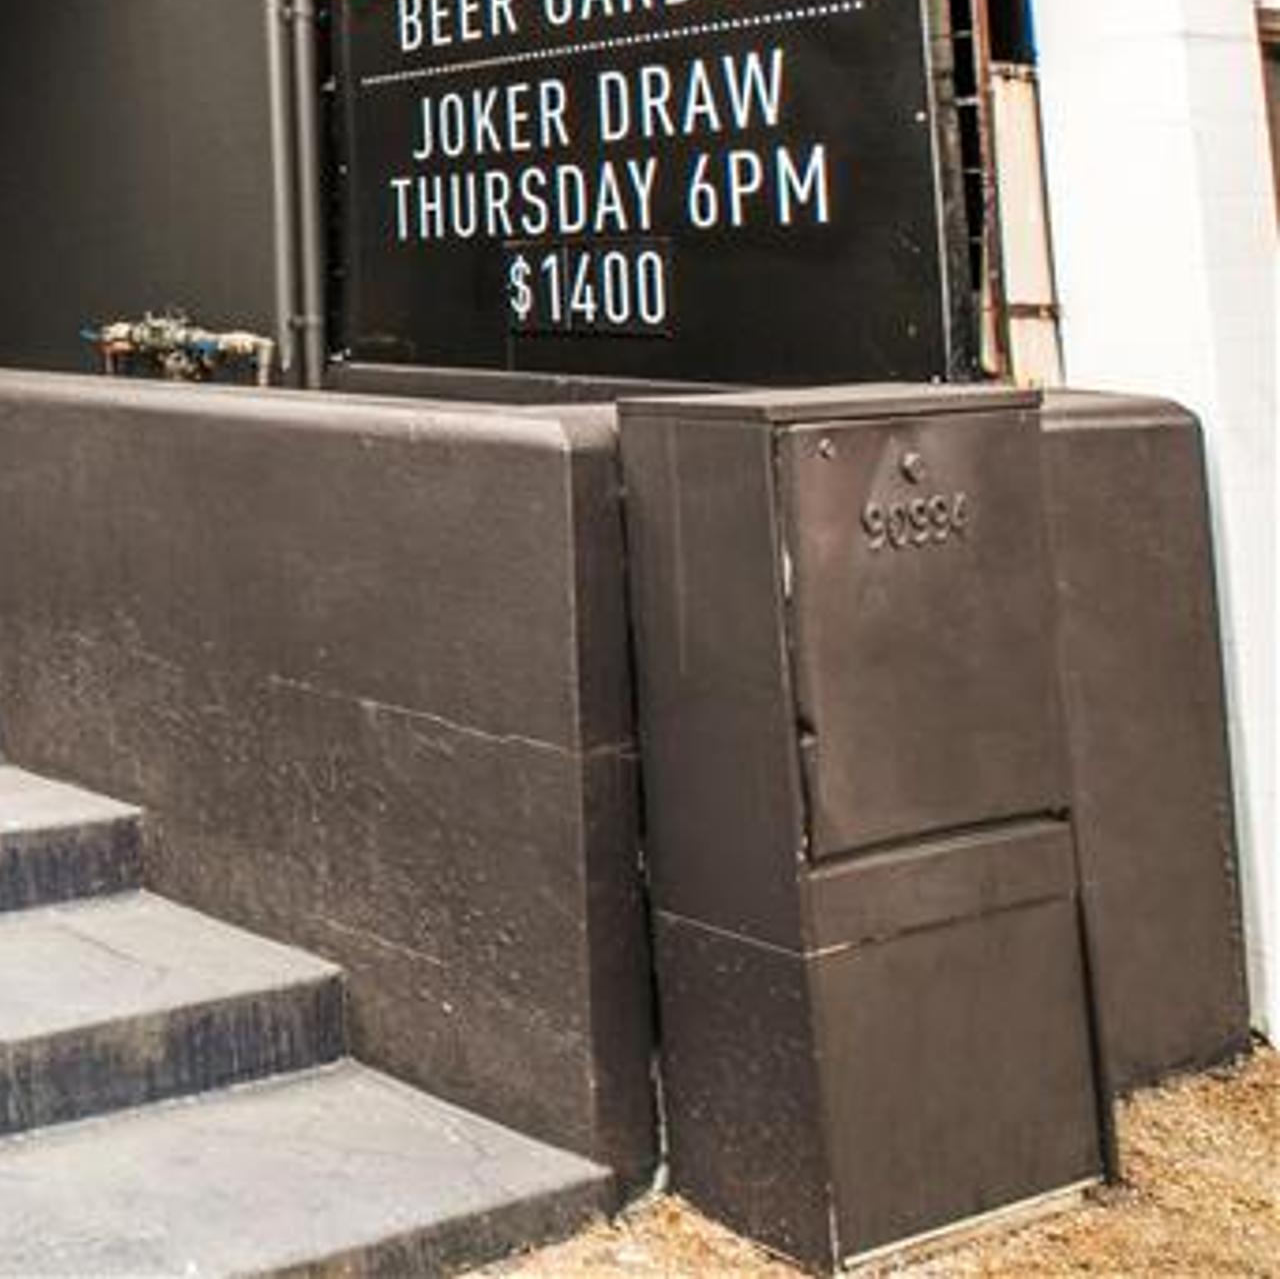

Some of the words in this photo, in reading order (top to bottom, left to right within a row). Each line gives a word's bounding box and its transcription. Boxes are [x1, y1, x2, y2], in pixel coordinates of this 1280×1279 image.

[412, 78, 570, 160] JOKER
[598, 48, 785, 142] DRAW
[390, 157, 658, 241] THURSDAY
[688, 144, 830, 228] 6PM
[509, 250, 667, 324] $1400
